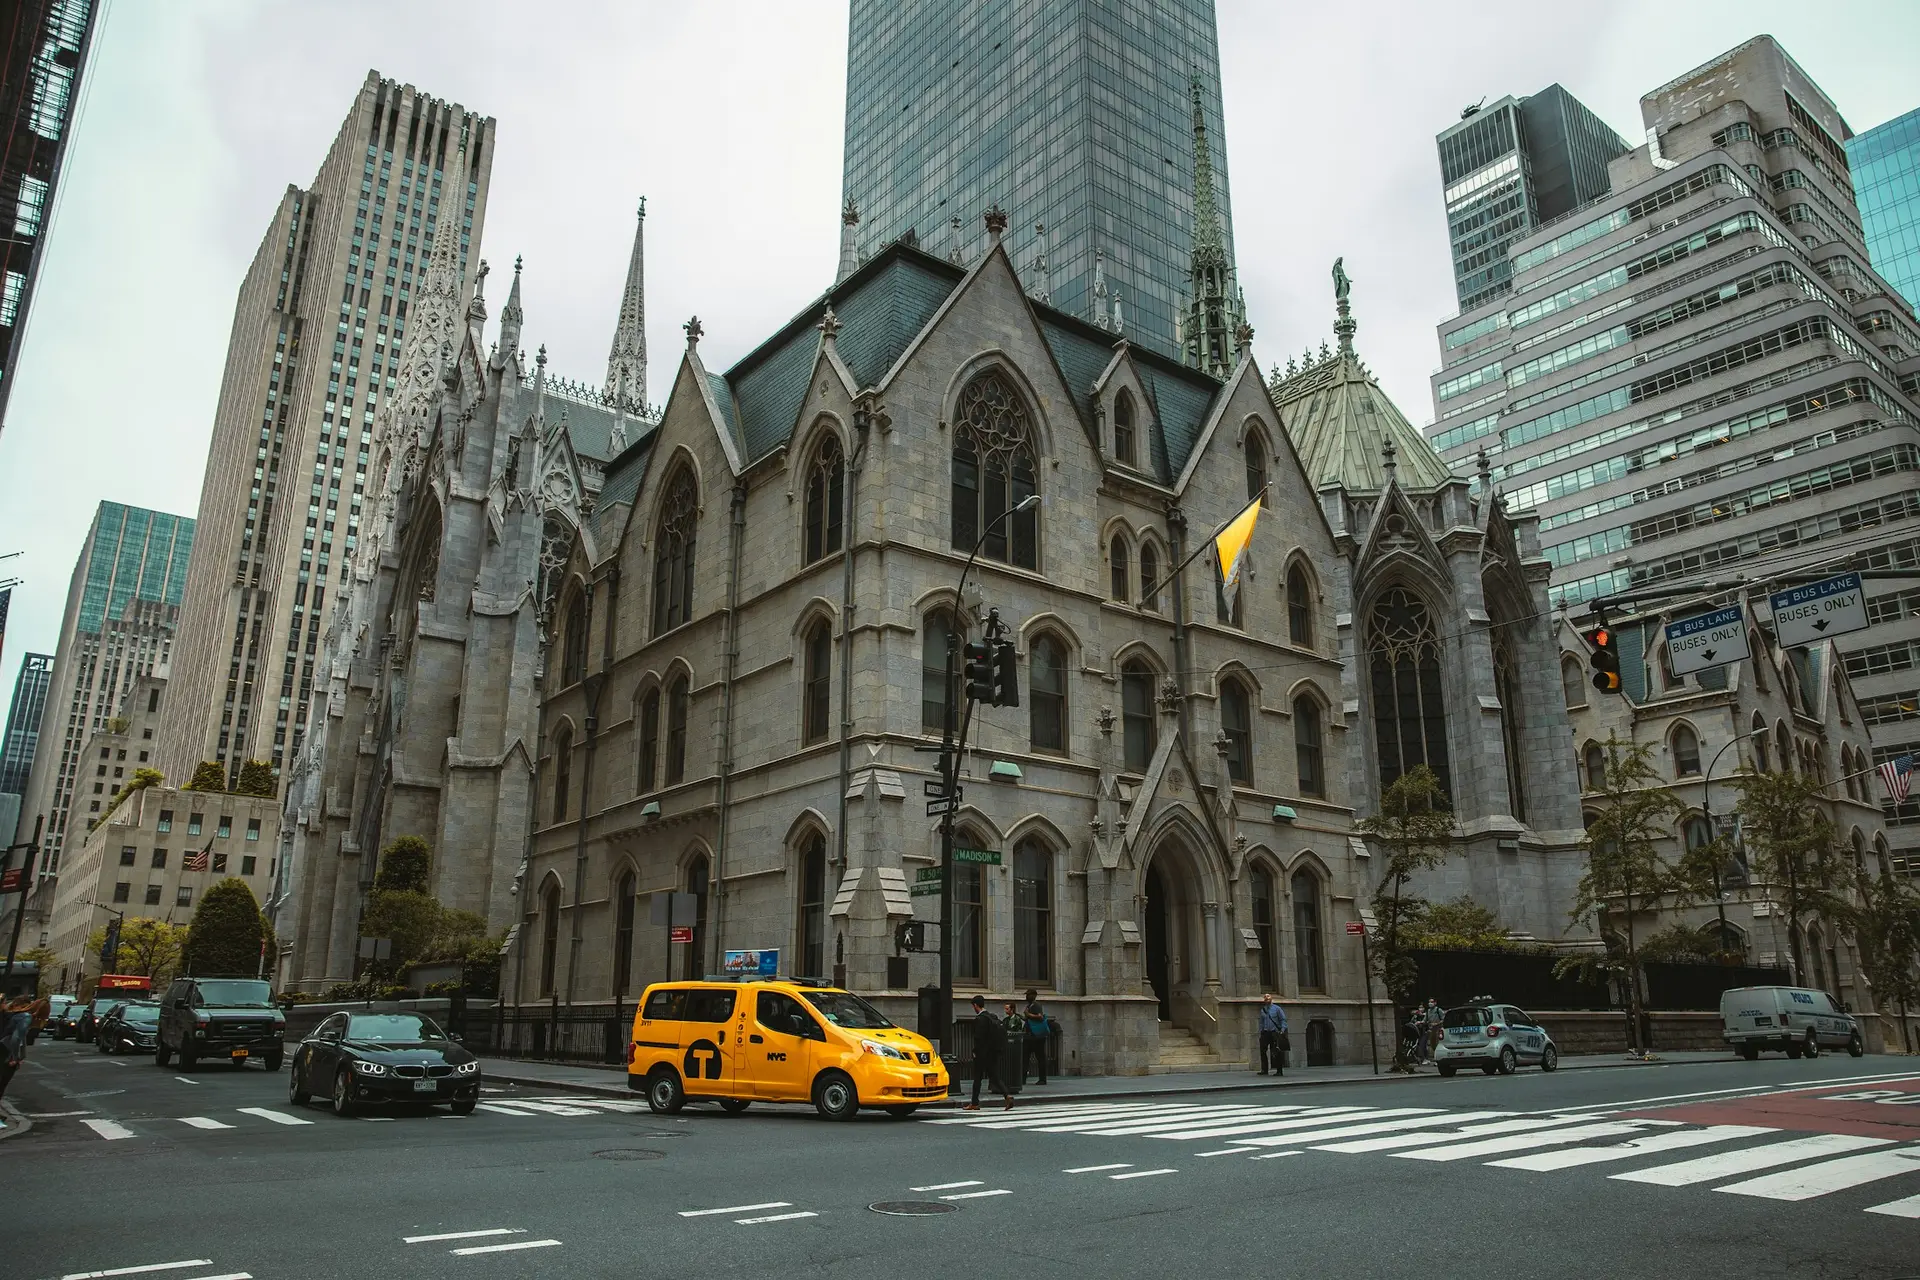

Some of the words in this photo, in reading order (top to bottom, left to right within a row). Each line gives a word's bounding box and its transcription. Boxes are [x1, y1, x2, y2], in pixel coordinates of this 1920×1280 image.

[1793, 588, 1817, 601] BUS
[1820, 577, 1854, 594] LANE
[1779, 604, 1819, 624] BUSES
[1824, 594, 1856, 612] ONLY
[1684, 620, 1705, 632] BUS
[1707, 610, 1737, 625] LANE
[1672, 635, 1708, 653] BUSES
[1711, 625, 1739, 643] ONLY
[960, 849, 992, 862] MADISON
[928, 869, 936, 879] 50
[1789, 991, 1814, 1005] POLICE
[767, 1052, 787, 1061] NYC
